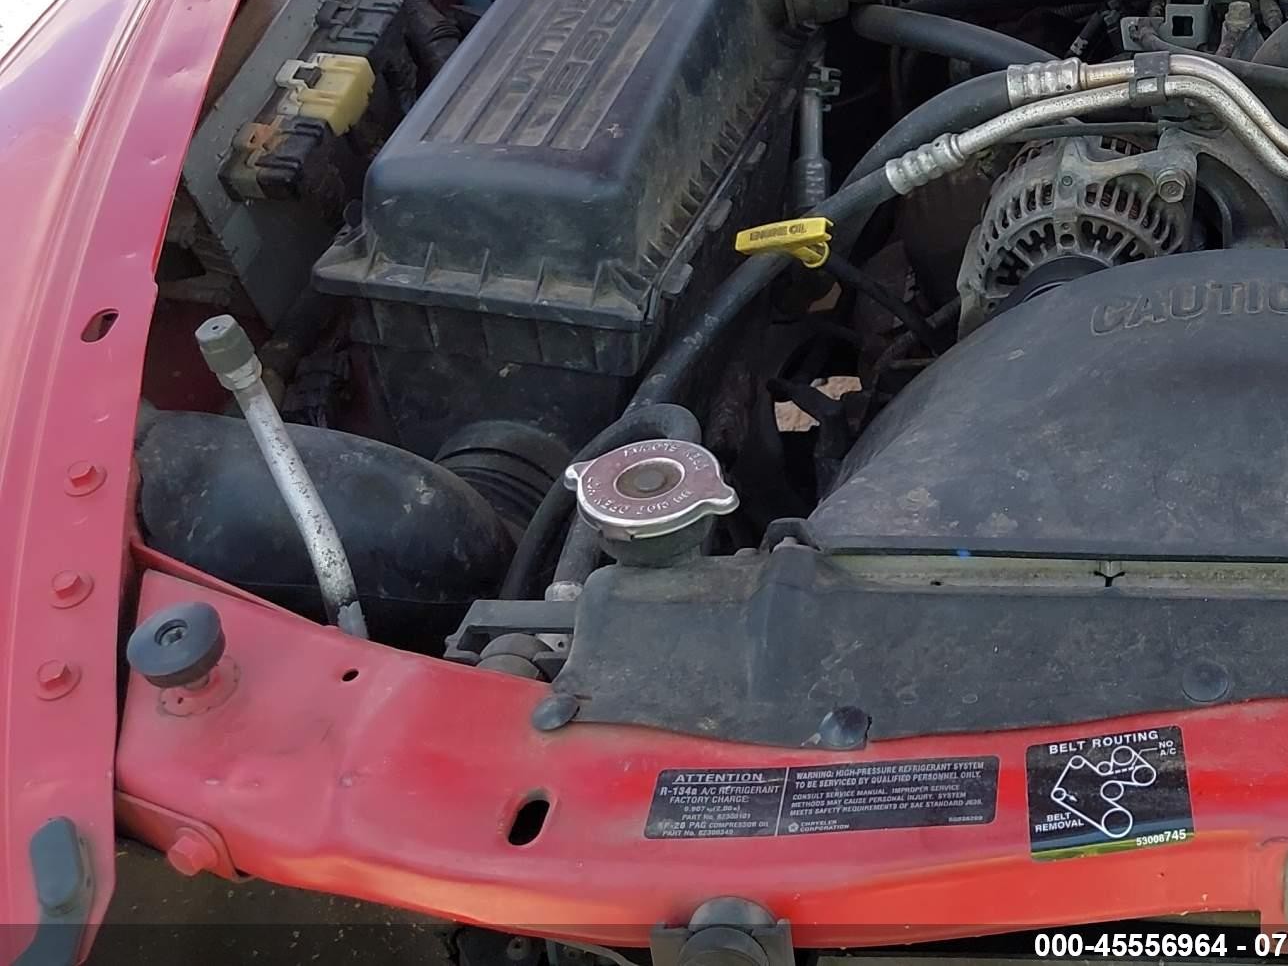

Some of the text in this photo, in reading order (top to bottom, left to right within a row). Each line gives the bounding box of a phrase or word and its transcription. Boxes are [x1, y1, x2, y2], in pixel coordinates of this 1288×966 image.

[1049, 730, 1159, 755] BELT ROUTING
[1158, 740, 1174, 749] NO
[1160, 747, 1177, 756] A/C
[674, 773, 763, 782] ATTENTION
[796, 761, 985, 781] WARNING: HIGH-PRESSURE REFRIGERANT SYSTEM
[795, 770, 982, 789] TO BE SERVICED BY QUALIFIED PERSONNEL ONLY.
[660, 785, 780, 796] R-134a A/C REFRIGERANT
[792, 792, 824, 800] CONSULT
[825, 789, 855, 798] SERVICE
[891, 785, 929, 794] IMPROPER
[930, 784, 960, 792] SERVICE
[669, 795, 710, 805] FACTORY
[790, 800, 825, 808] METHODS
[827, 799, 842, 807] MAY
[843, 796, 867, 805] CAUSE
[868, 794, 905, 804] PERSONAL
[937, 791, 967, 799] SYSTEM
[789, 808, 813, 816] MEETS
[814, 806, 841, 815] SAFETY
[842, 803, 898, 813] REQUIREMENTS
[899, 802, 909, 810] OF
[925, 799, 964, 808] STANDARD
[1046, 812, 1071, 823] BELT
[688, 821, 706, 829] PAG
[1035, 819, 1085, 833] REMOVAL
[1136, 828, 1187, 846] 53008745
